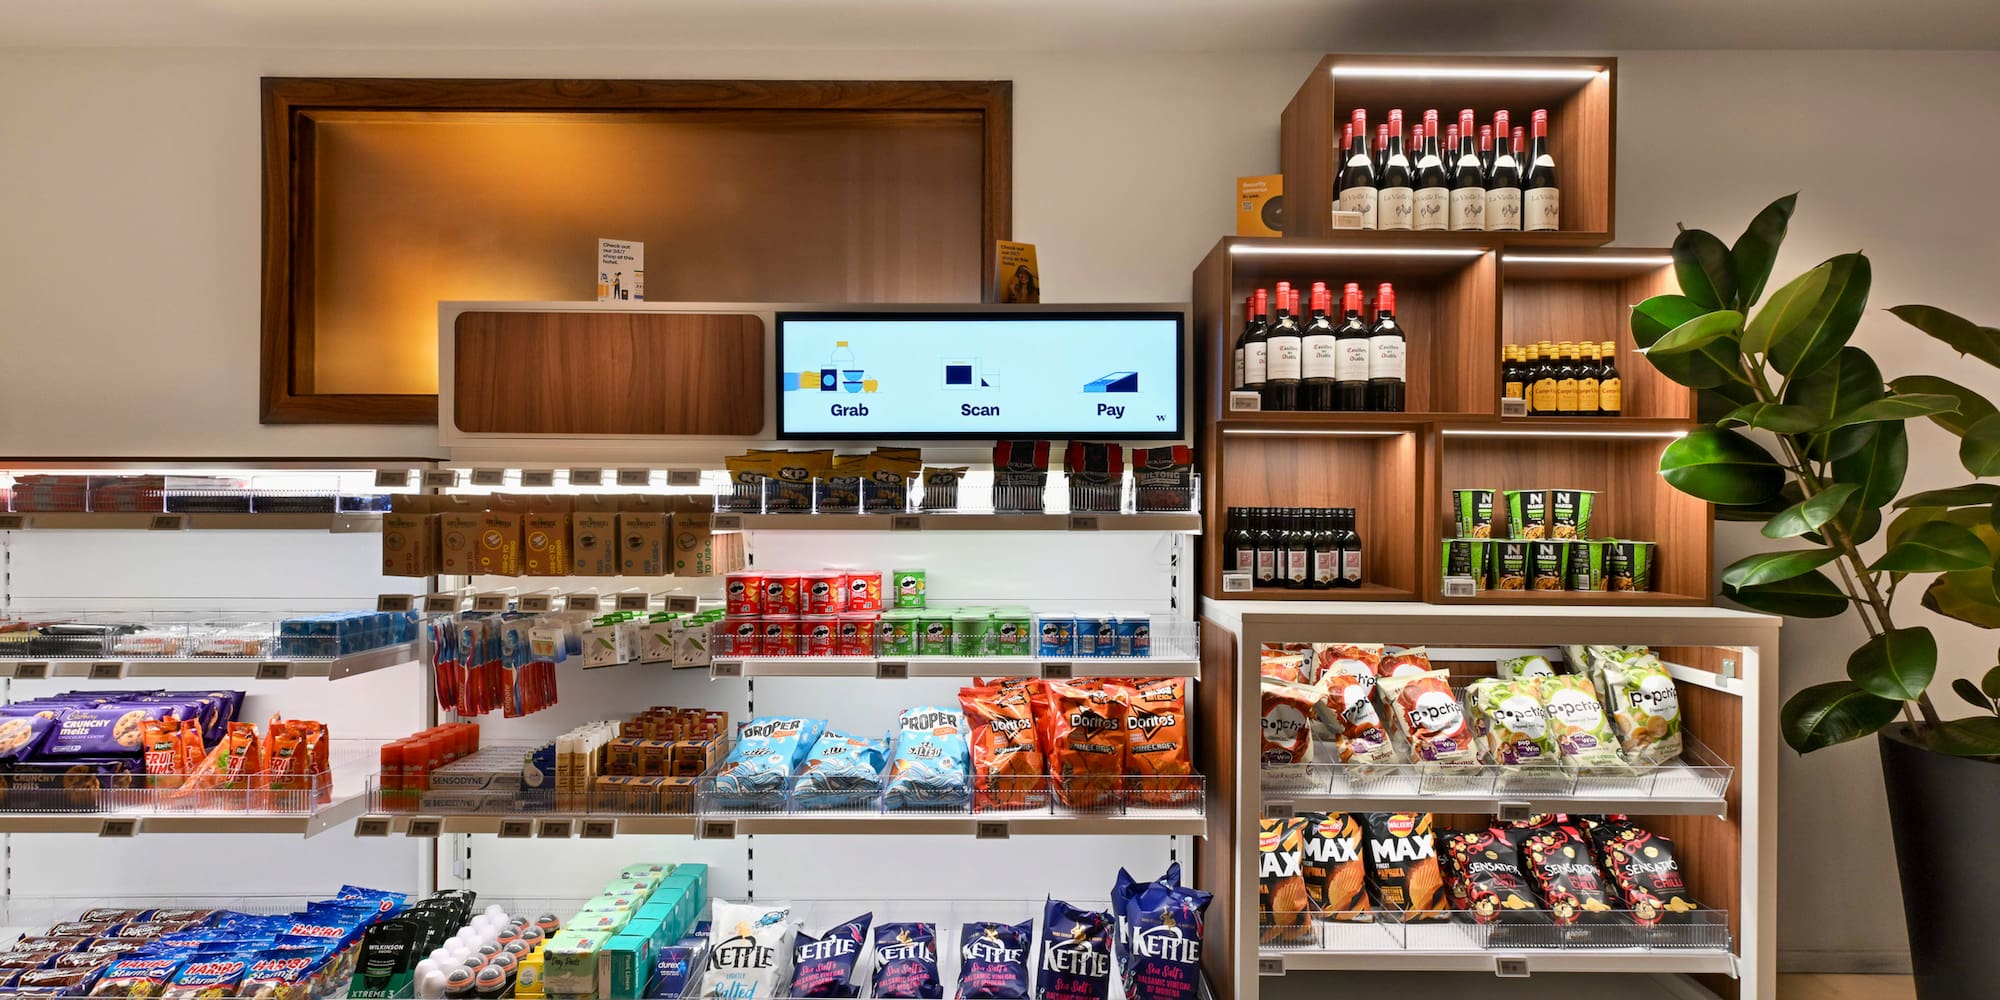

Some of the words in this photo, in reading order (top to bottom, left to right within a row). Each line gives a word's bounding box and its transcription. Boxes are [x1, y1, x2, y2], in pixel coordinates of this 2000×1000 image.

[831, 403, 869, 418] Grab
[961, 402, 1000, 418] Scan
[1097, 403, 1125, 420] Pay
[782, 469, 806, 479] KP
[876, 472, 900, 482] KP
[932, 475, 953, 484] KP
[1482, 493, 1491, 504] N
[1530, 493, 1542, 504] N
[1557, 493, 1570, 504] N
[503, 544, 509, 552] TO
[549, 544, 555, 552] TO
[1508, 544, 1521, 554] N
[1540, 544, 1553, 554] N
[705, 564, 711, 573] TO
[1630, 687, 1677, 707] popchip
[1410, 702, 1463, 728] popchip
[1494, 706, 1546, 724] popchip
[1546, 701, 1600, 718] popchip
[901, 711, 958, 730] PROPER
[991, 717, 1031, 732] Doritos
[1071, 714, 1118, 730] Doritos
[1128, 714, 1175, 729] Doritos
[744, 720, 800, 738] PROPER
[1070, 743, 1116, 754] MINECRAFT
[1132, 743, 1176, 754] MINECRAFT
[1302, 838, 1359, 862] MAX
[1371, 834, 1434, 863] MAX
[1468, 862, 1522, 876] SENSATION
[1625, 860, 1678, 876] SENSATIO
[1572, 880, 1597, 890] CHILLI
[1654, 879, 1683, 889] CHILLI
[963, 936, 1023, 964] KETTLE
[1132, 925, 1200, 964] KETTLE
[706, 936, 775, 972] KETTLE
[1043, 940, 1108, 977] KETTLE
[184, 962, 244, 975] HARIBO
[252, 957, 313, 971] HARIBO
[552, 958, 563, 968] Day
[565, 958, 580, 966] Pads
[1146, 962, 1160, 975] Sea
[1162, 965, 1178, 980] Salt
[714, 980, 758, 1000] Salted
[1055, 978, 1069, 991] Sea
[1071, 980, 1088, 994] Salt
[388, 990, 395, 999] 3
